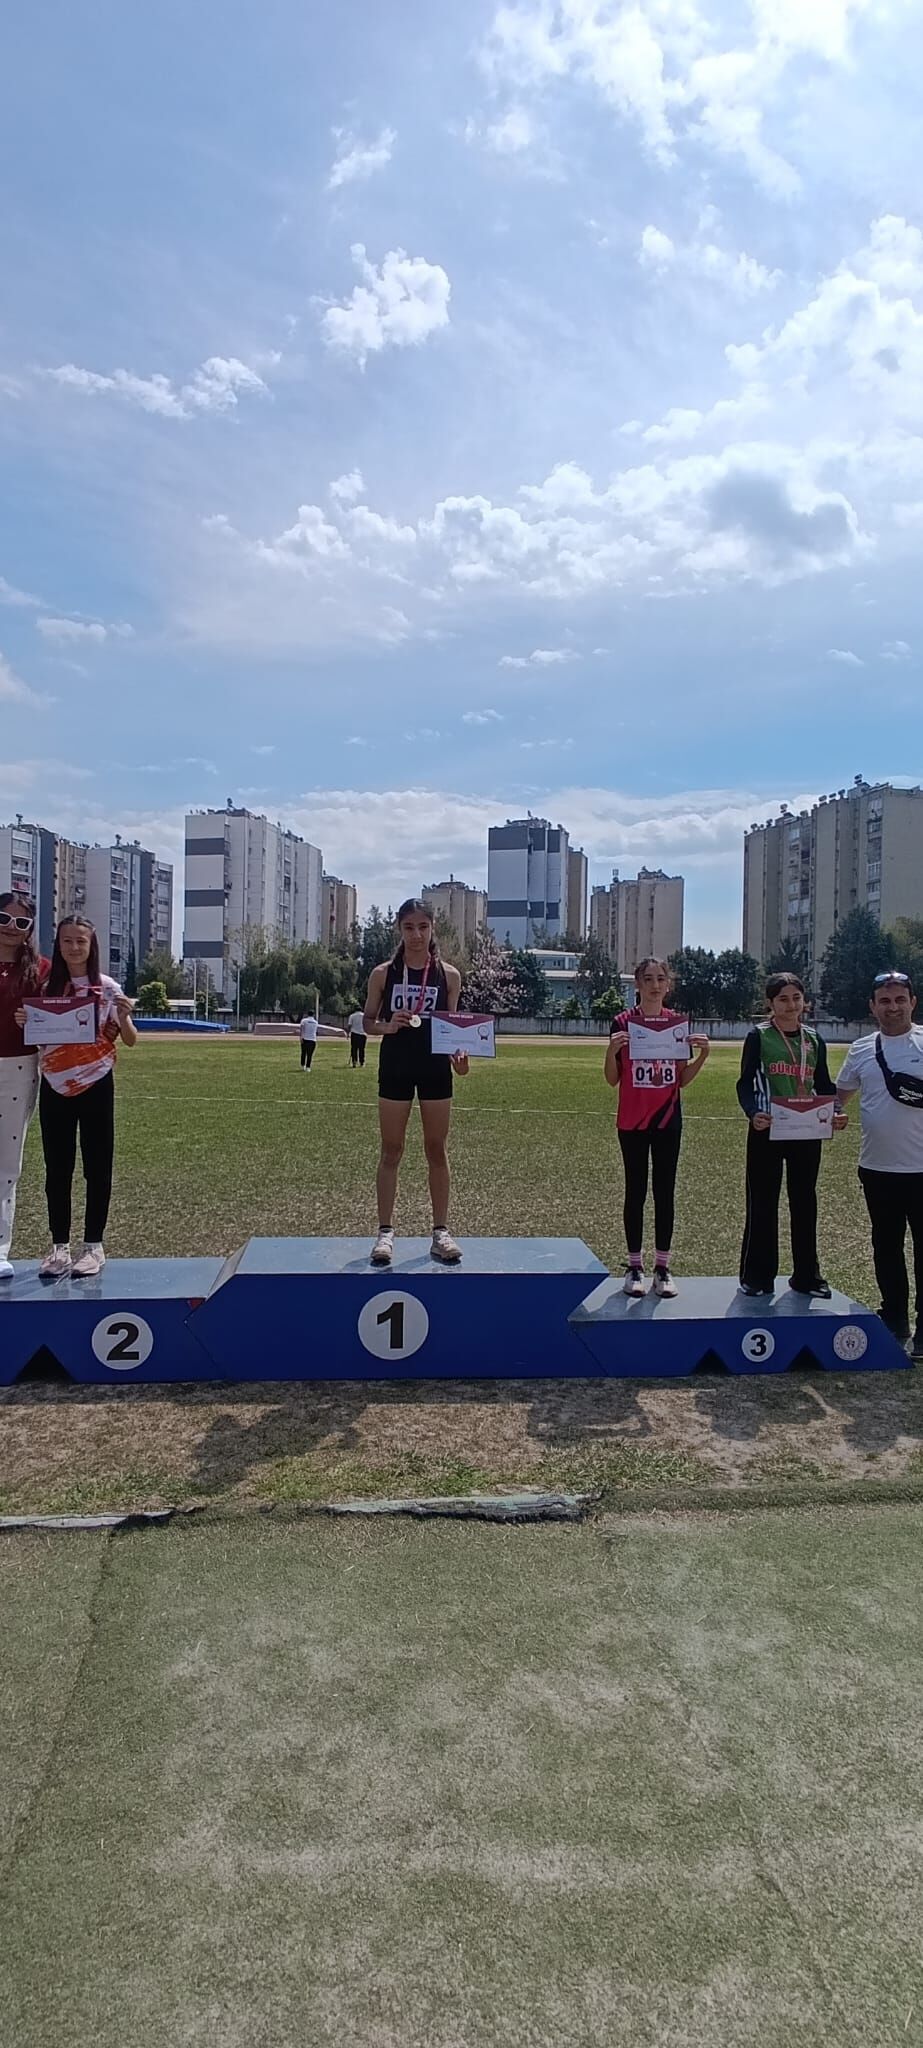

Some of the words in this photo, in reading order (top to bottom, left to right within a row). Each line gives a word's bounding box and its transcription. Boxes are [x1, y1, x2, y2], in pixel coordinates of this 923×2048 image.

[635, 1067, 674, 1082] 018
[376, 1302, 404, 1349] 1
[106, 1322, 140, 1361] 2
[750, 1334, 767, 1357] 3
